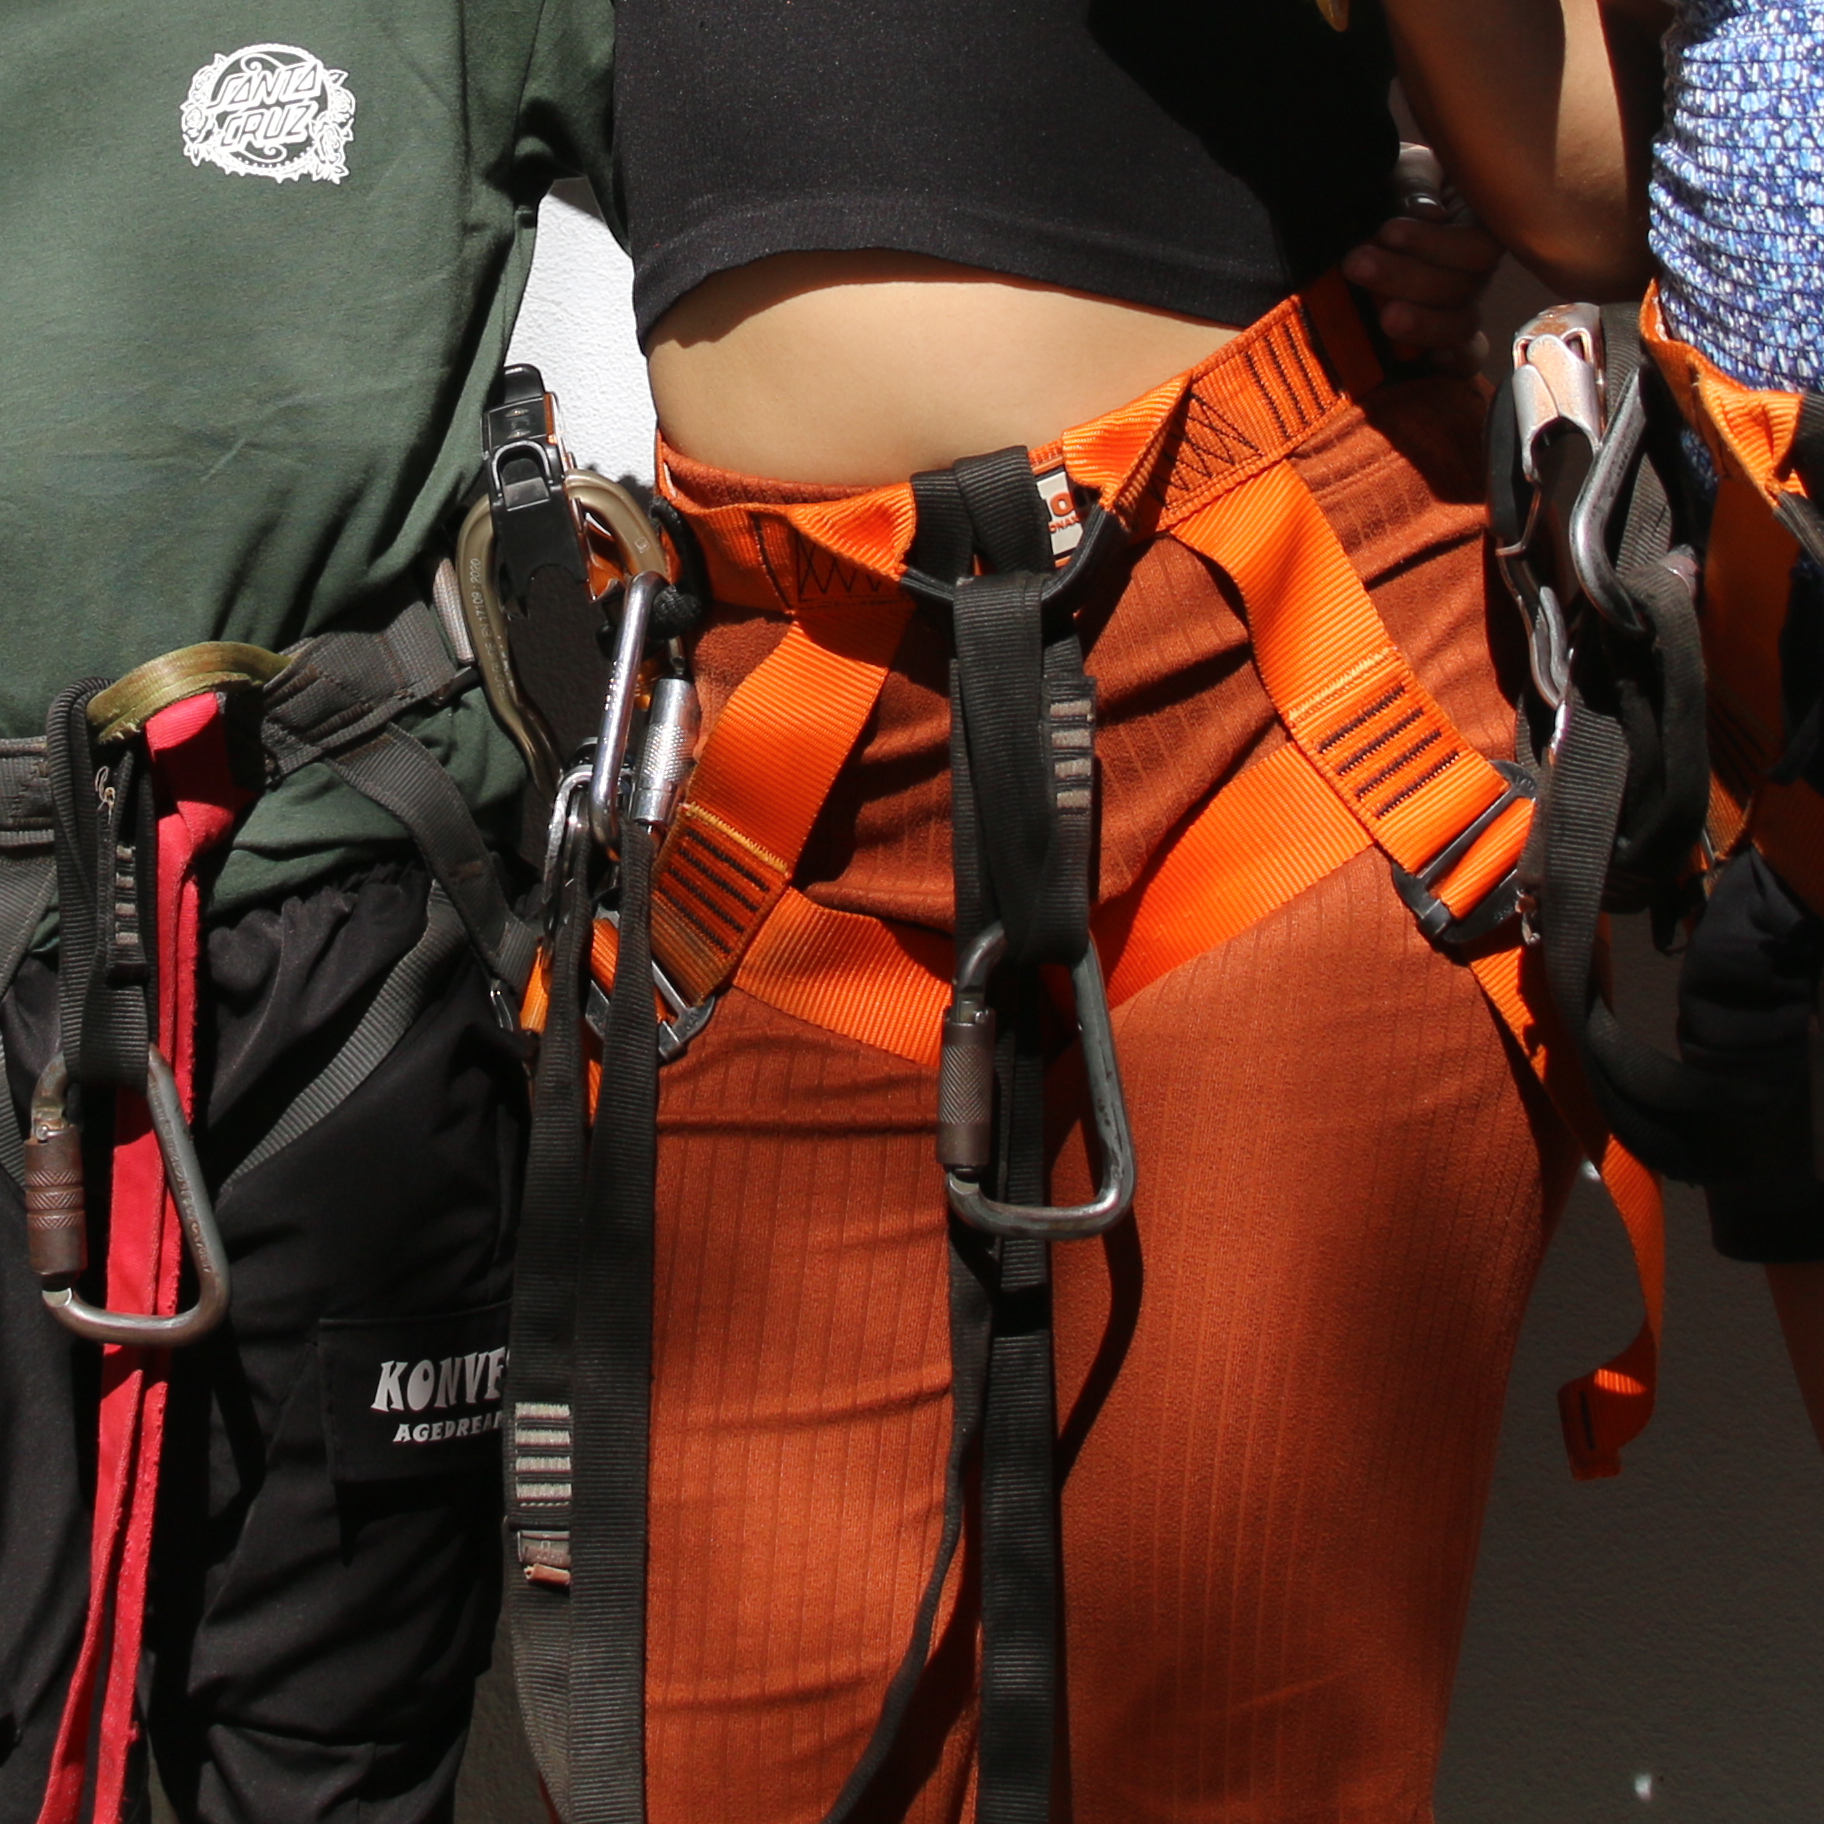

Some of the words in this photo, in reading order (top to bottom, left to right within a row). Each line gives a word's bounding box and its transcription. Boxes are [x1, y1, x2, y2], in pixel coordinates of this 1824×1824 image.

[206, 60, 324, 113] SANTA
[220, 100, 319, 154] CRUZ
[371, 1346, 510, 1412] KONVE
